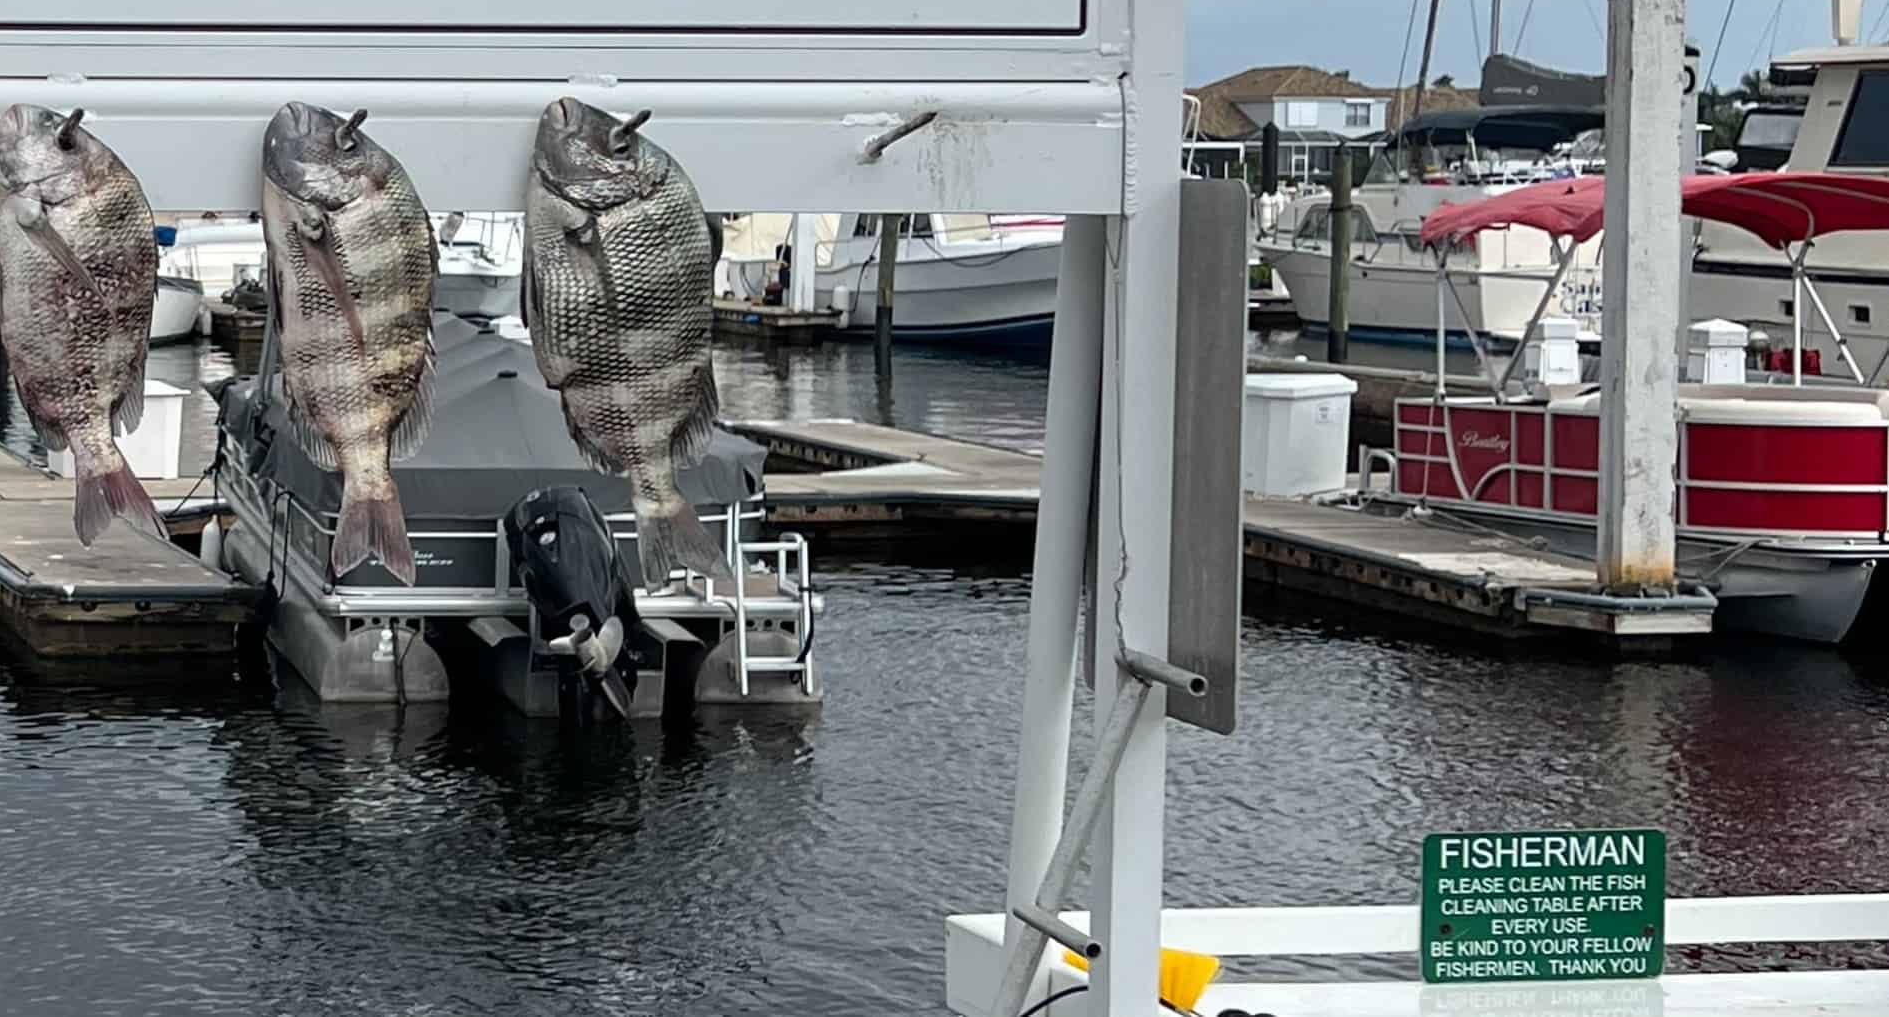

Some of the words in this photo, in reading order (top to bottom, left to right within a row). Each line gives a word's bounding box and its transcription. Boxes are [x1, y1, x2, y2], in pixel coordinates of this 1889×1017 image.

[1441, 835, 1644, 869] FISHERMAN
[1439, 878, 1504, 894] PLEASE
[1509, 877, 1565, 892] CLEAN
[1569, 875, 1603, 891] THE
[1607, 875, 1645, 890] FISH
[1441, 899, 1528, 915] CLEANING
[1531, 897, 1584, 912] TABLE
[1587, 895, 1642, 911] AFTER
[1492, 919, 1549, 934] EVERY
[1553, 917, 1591, 933] USE.
[1431, 941, 1453, 957] BE
[1458, 940, 1498, 956] KIND
[1502, 939, 1526, 955] TO
[1530, 938, 1579, 954] YOUR
[1583, 937, 1652, 953] FELLOW
[1548, 959, 1606, 974] THANK
[1609, 958, 1646, 973] YOU
